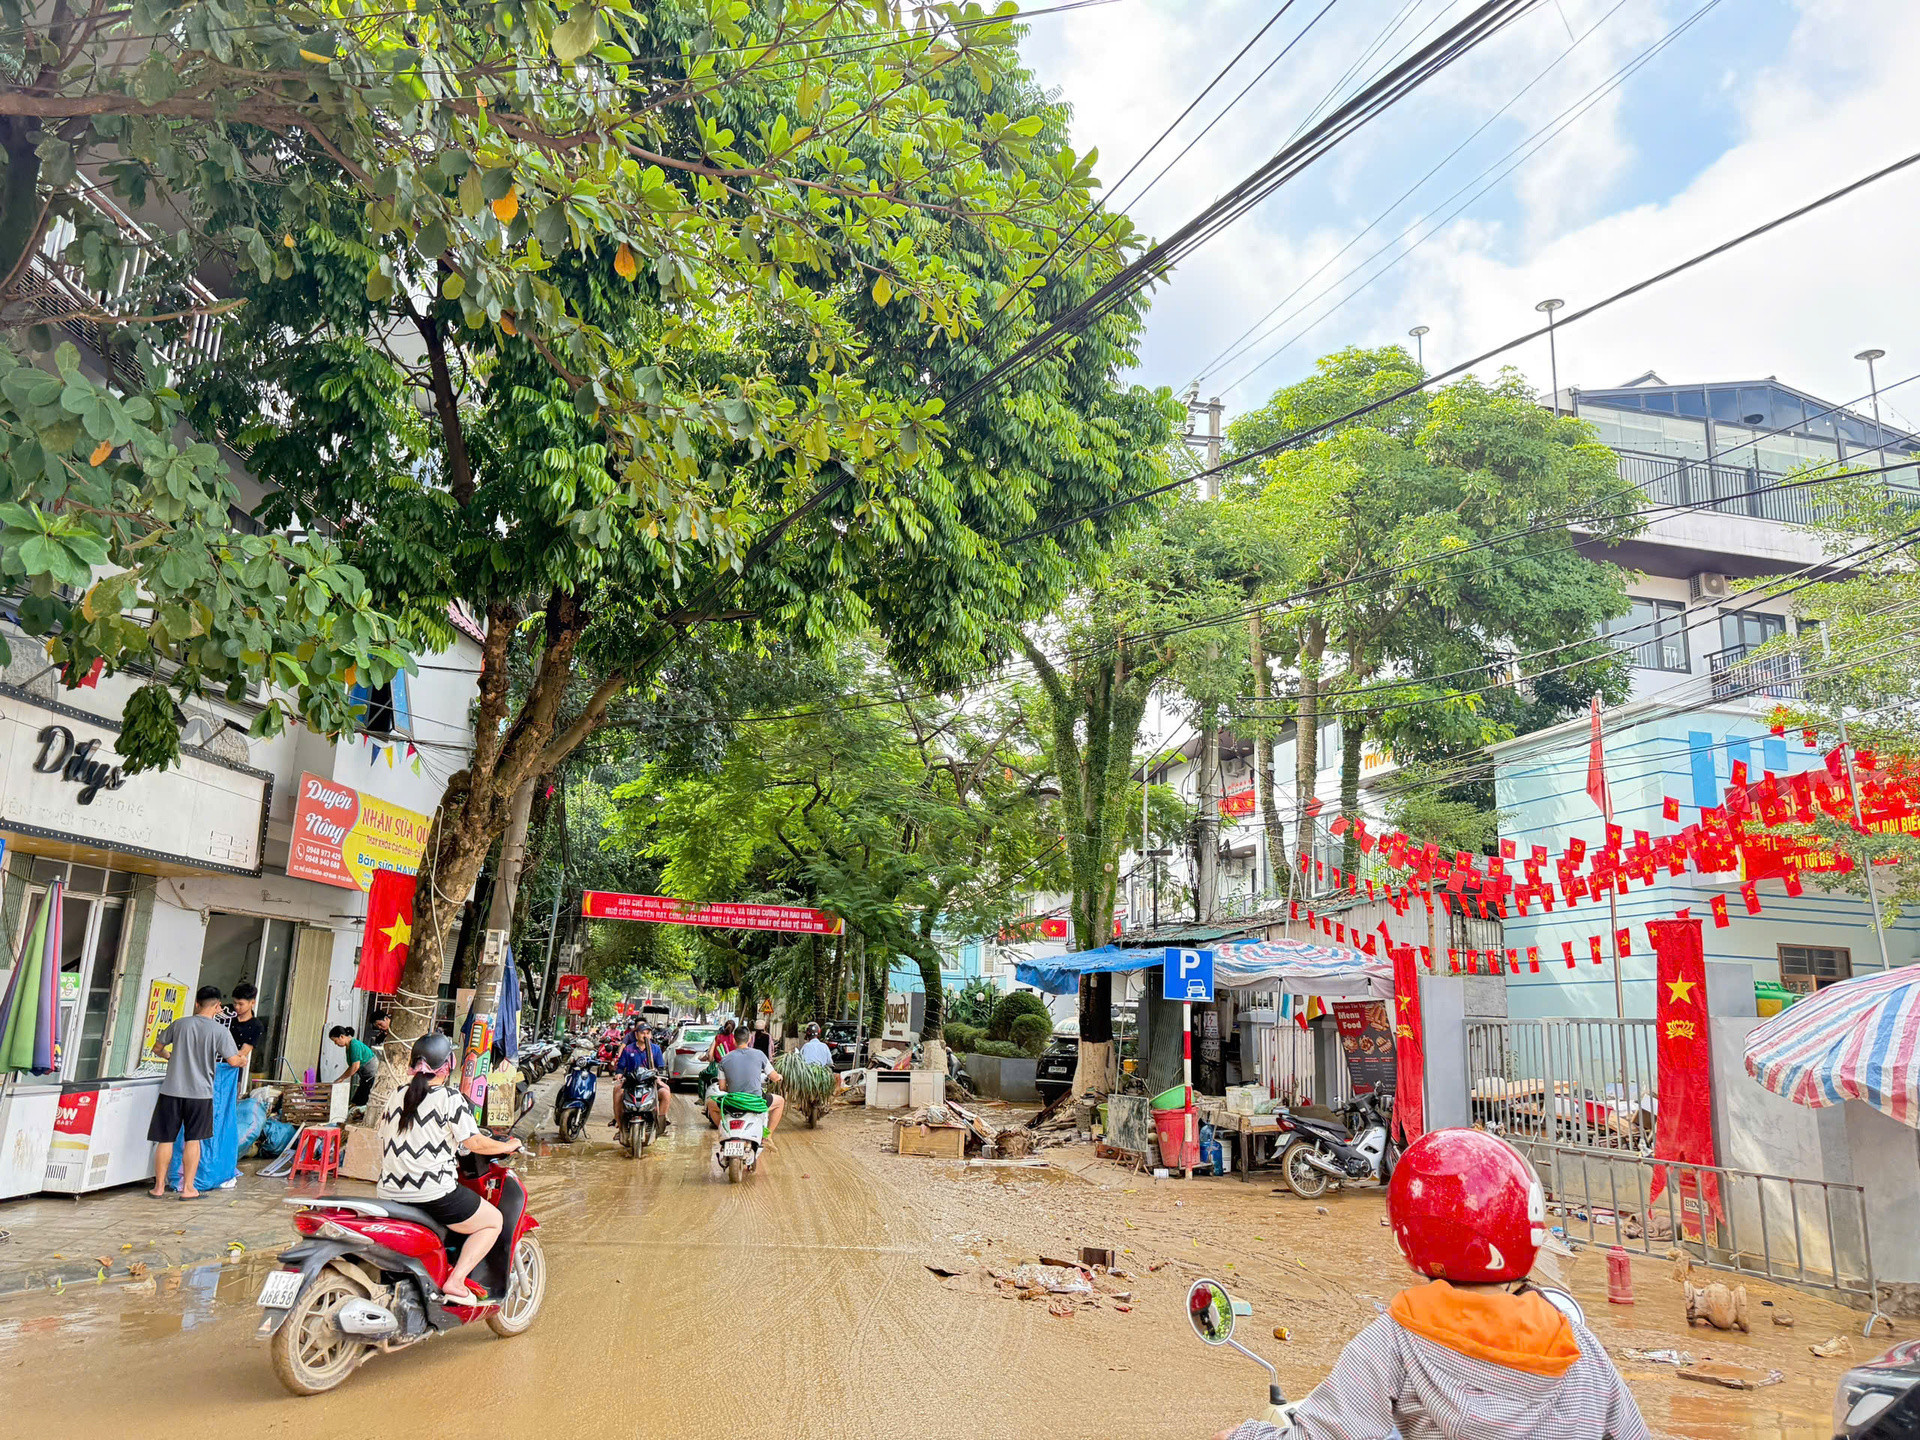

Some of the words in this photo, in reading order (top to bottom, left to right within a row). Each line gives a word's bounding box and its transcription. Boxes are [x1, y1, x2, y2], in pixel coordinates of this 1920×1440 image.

[305, 779, 353, 810] Duyên
[305, 812, 346, 845] Nông
[358, 852, 376, 868] Bán
[1180, 950, 1200, 978] P
[164, 986, 177, 1003] MÍA
[1337, 1011, 1360, 1020] Menu
[1342, 1020, 1362, 1029] Food
